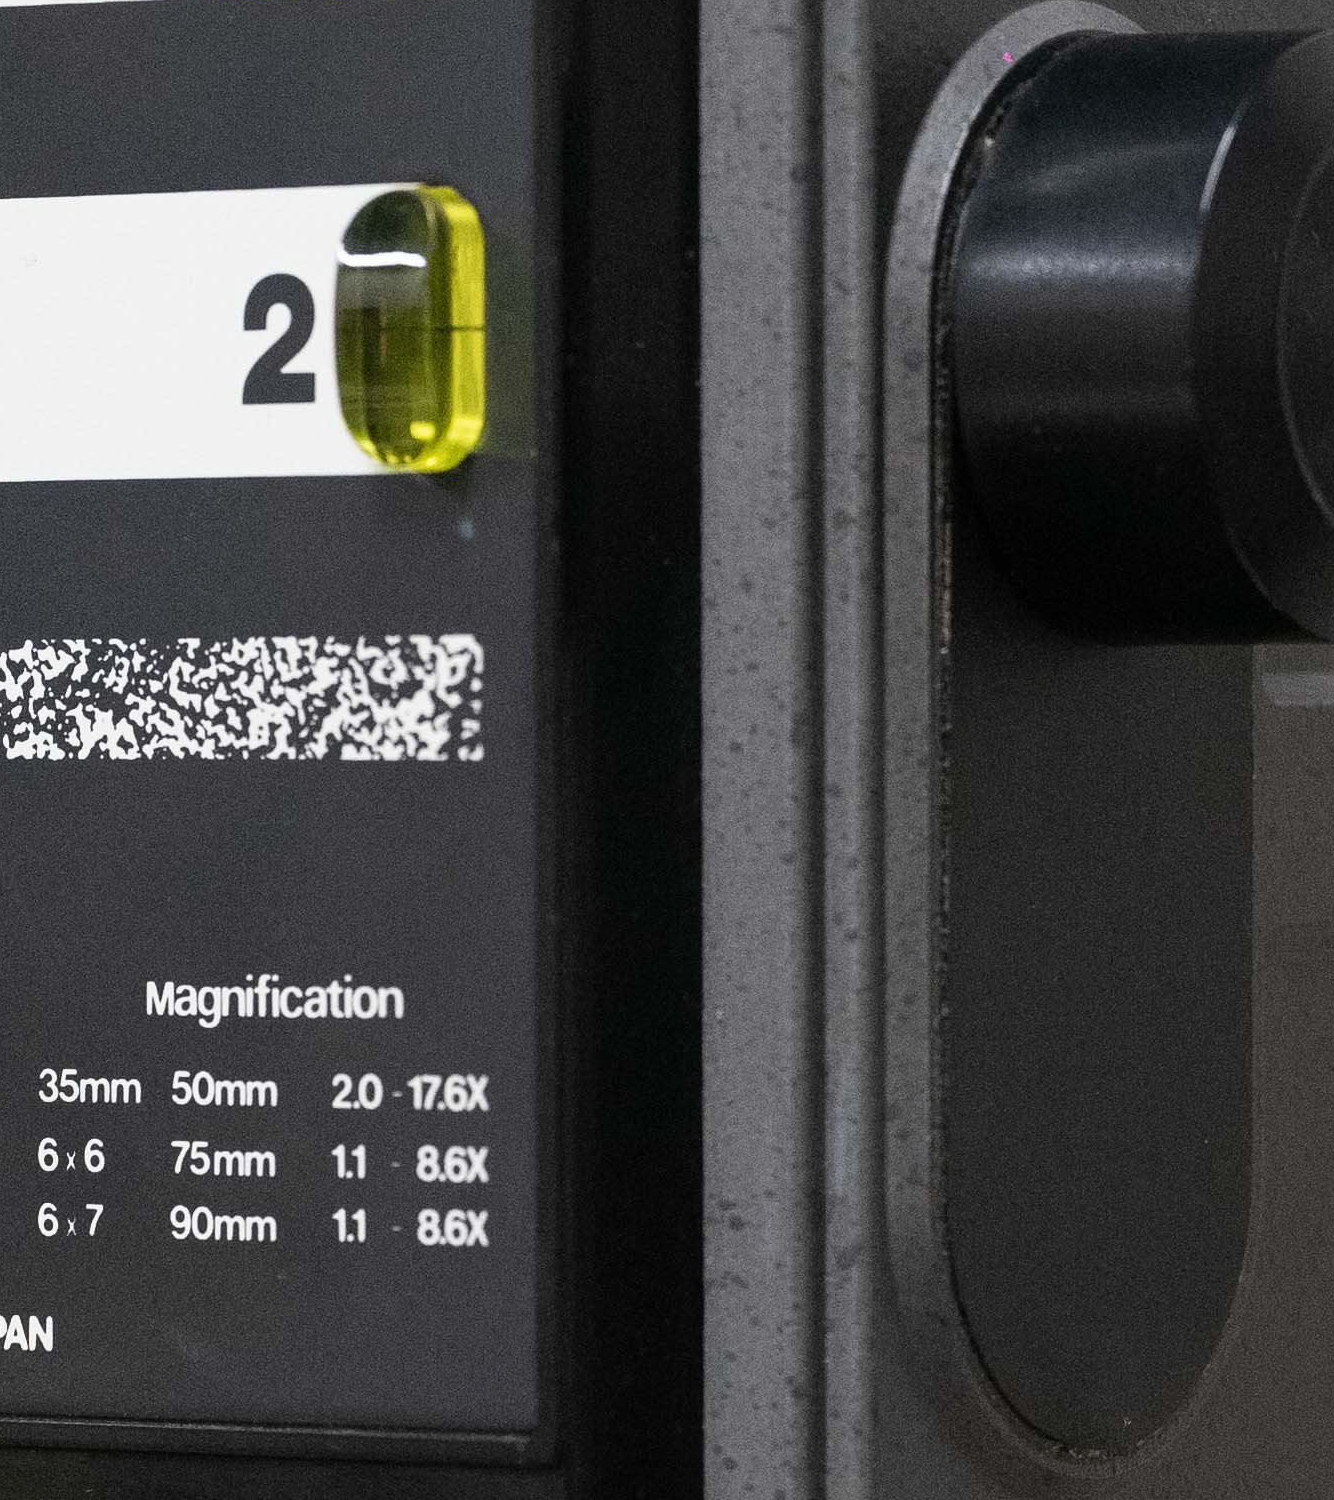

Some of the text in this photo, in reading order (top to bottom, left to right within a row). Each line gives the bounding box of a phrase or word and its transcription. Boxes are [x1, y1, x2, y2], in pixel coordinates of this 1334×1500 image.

[242, 273, 316, 405] 2
[145, 973, 405, 1030] Magnification
[38, 1068, 142, 1104] 35mm
[171, 1070, 279, 1107] 50mm
[331, 1072, 384, 1110] 2.0
[170, 1140, 277, 1178] 75mm
[331, 1143, 367, 1180] 1.1
[415, 1144, 490, 1184] 8.6X
[169, 1204, 278, 1242] 90mm
[332, 1208, 367, 1243] 1.1
[416, 1208, 490, 1247] 8.6X
